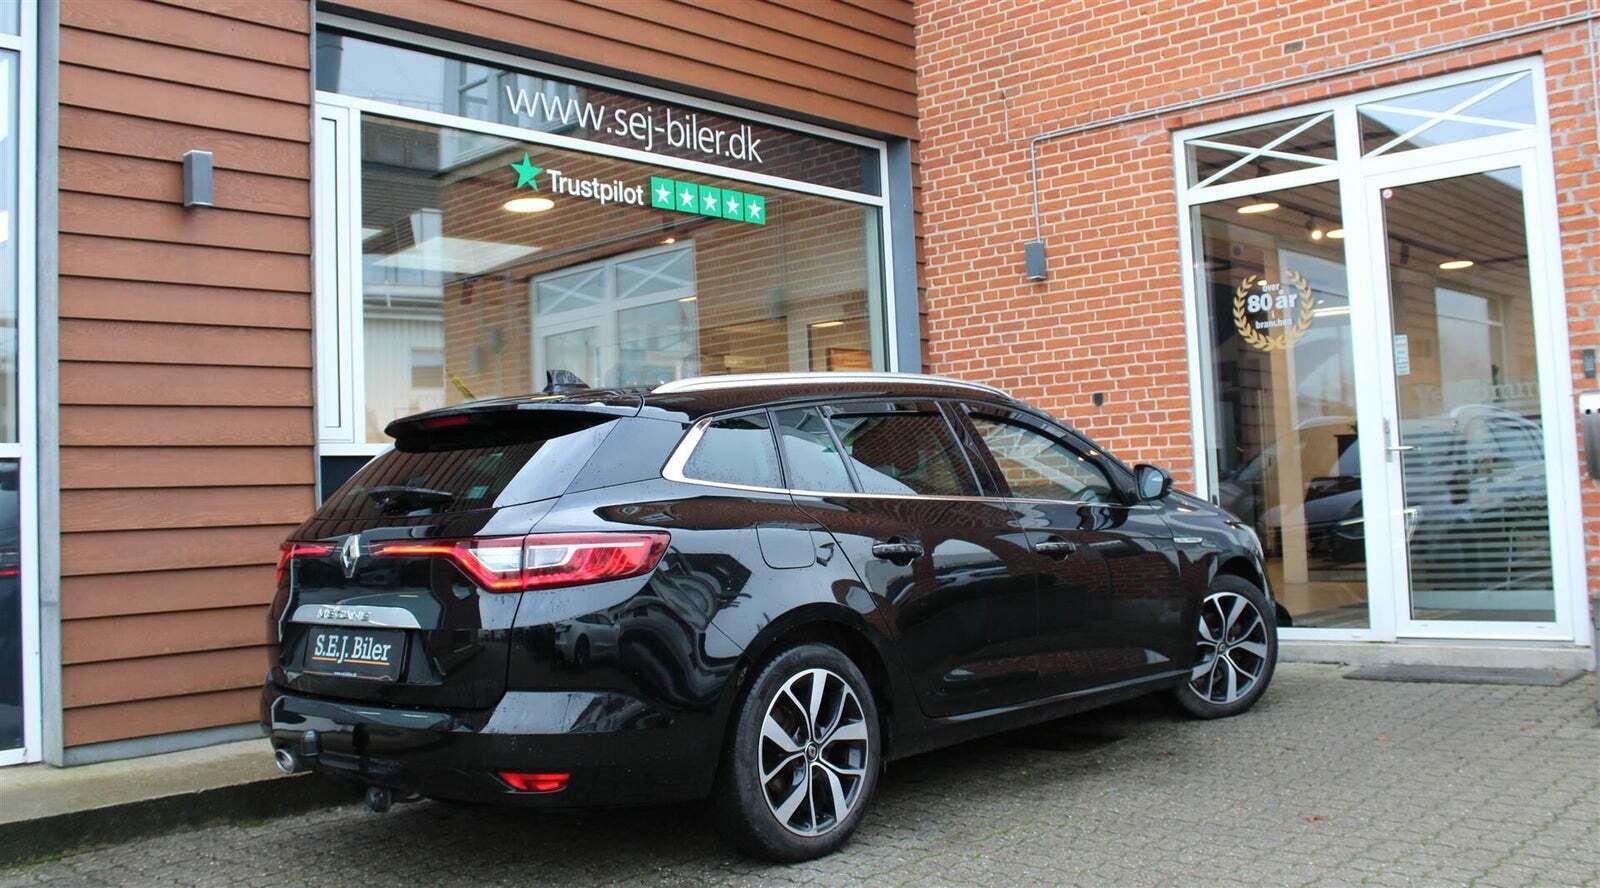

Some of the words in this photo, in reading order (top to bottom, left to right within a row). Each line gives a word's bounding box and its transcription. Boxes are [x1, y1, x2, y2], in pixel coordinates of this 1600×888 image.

[506, 85, 764, 163] www.sej-biler.dk
[546, 168, 644, 207] Trustpilot
[1247, 293, 1273, 313] 80
[1275, 289, 1298, 309] år
[314, 633, 349, 663] S.E.J.
[351, 635, 391, 661] Biler
